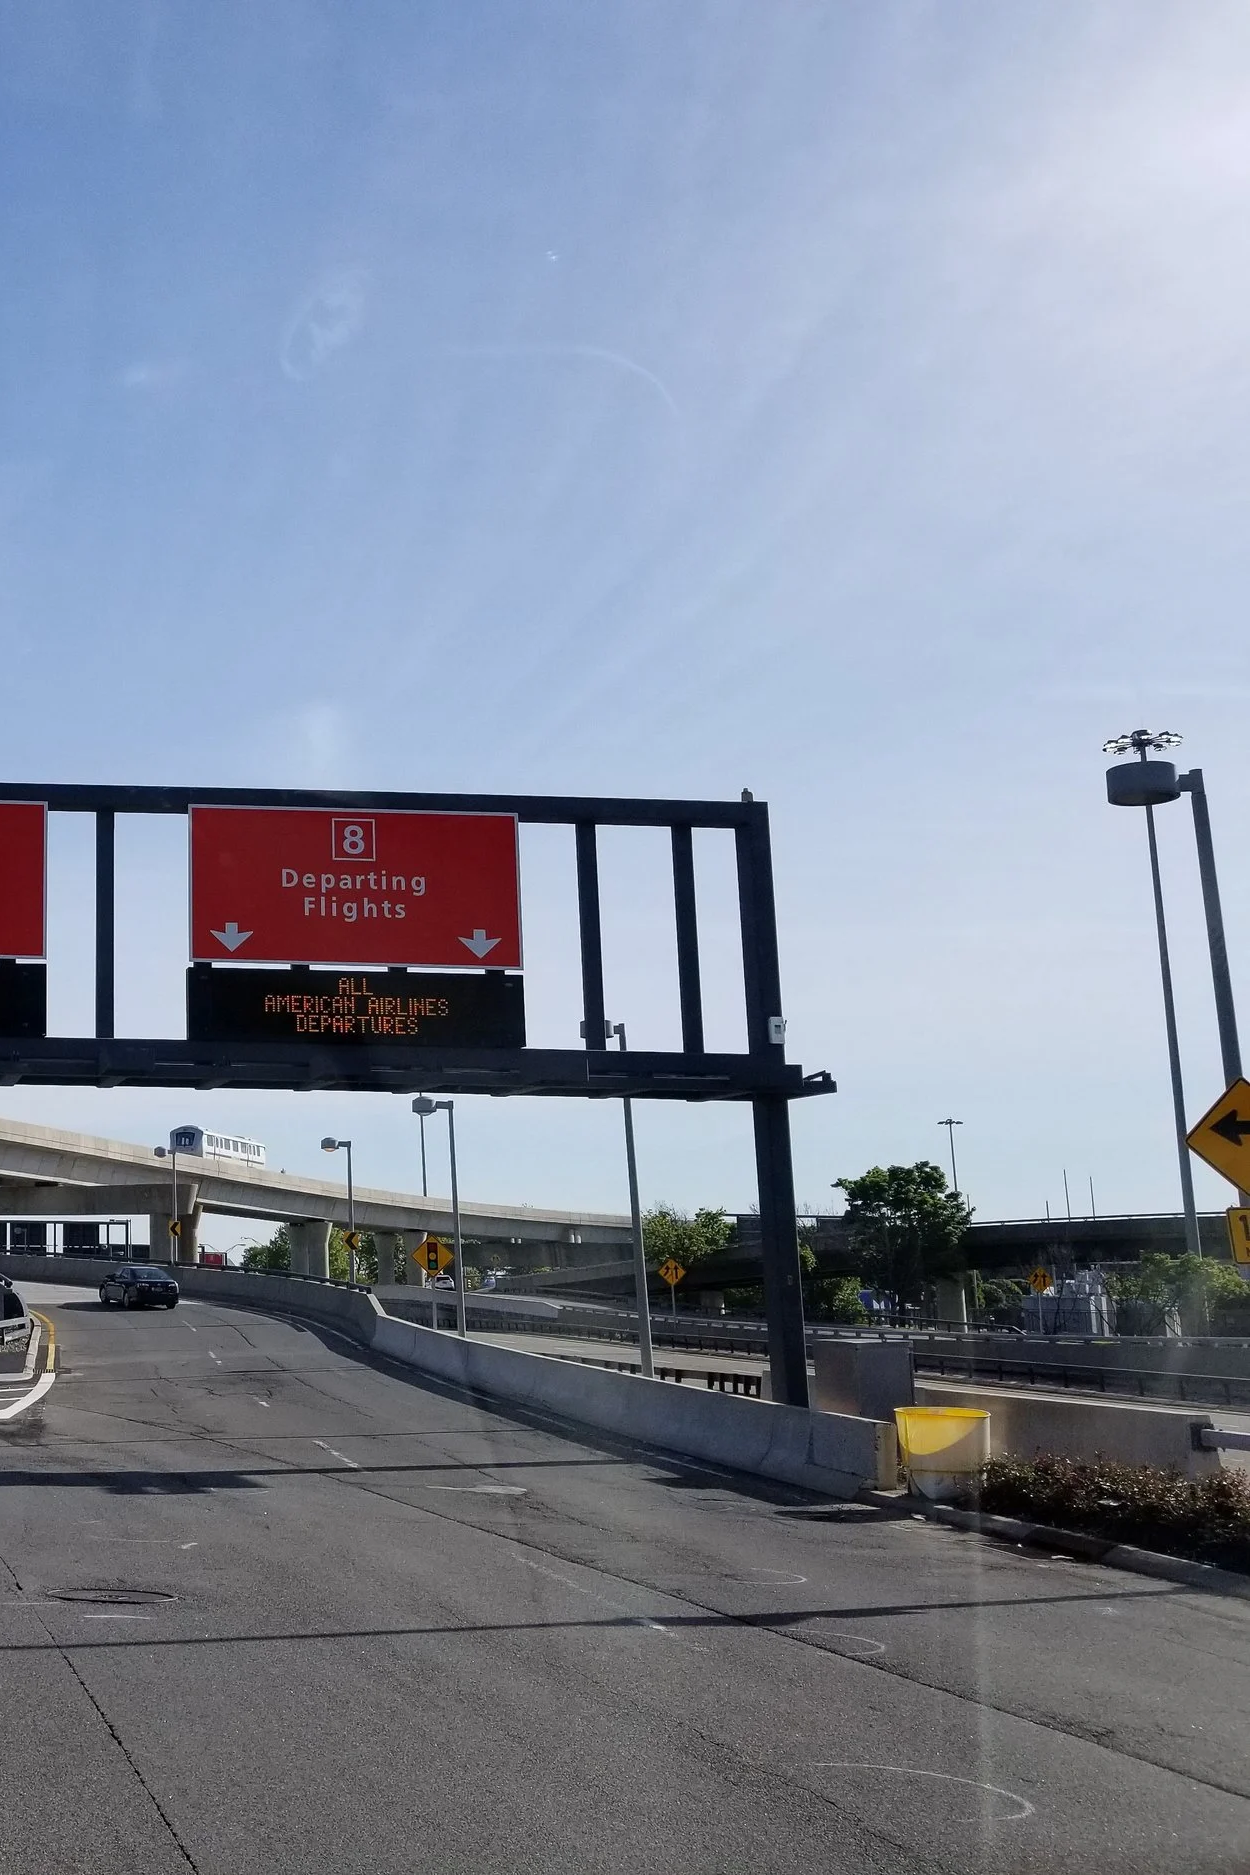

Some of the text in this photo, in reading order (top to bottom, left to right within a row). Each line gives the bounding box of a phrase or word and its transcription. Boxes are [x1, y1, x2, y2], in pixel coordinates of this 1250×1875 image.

[342, 825, 365, 854] 8
[281, 868, 427, 896] Departing
[304, 897, 406, 922] Flights
[338, 977, 374, 995] ALL
[264, 994, 448, 1016] AMERICAN AIRLINES
[296, 1014, 419, 1035] DEPARTURES
